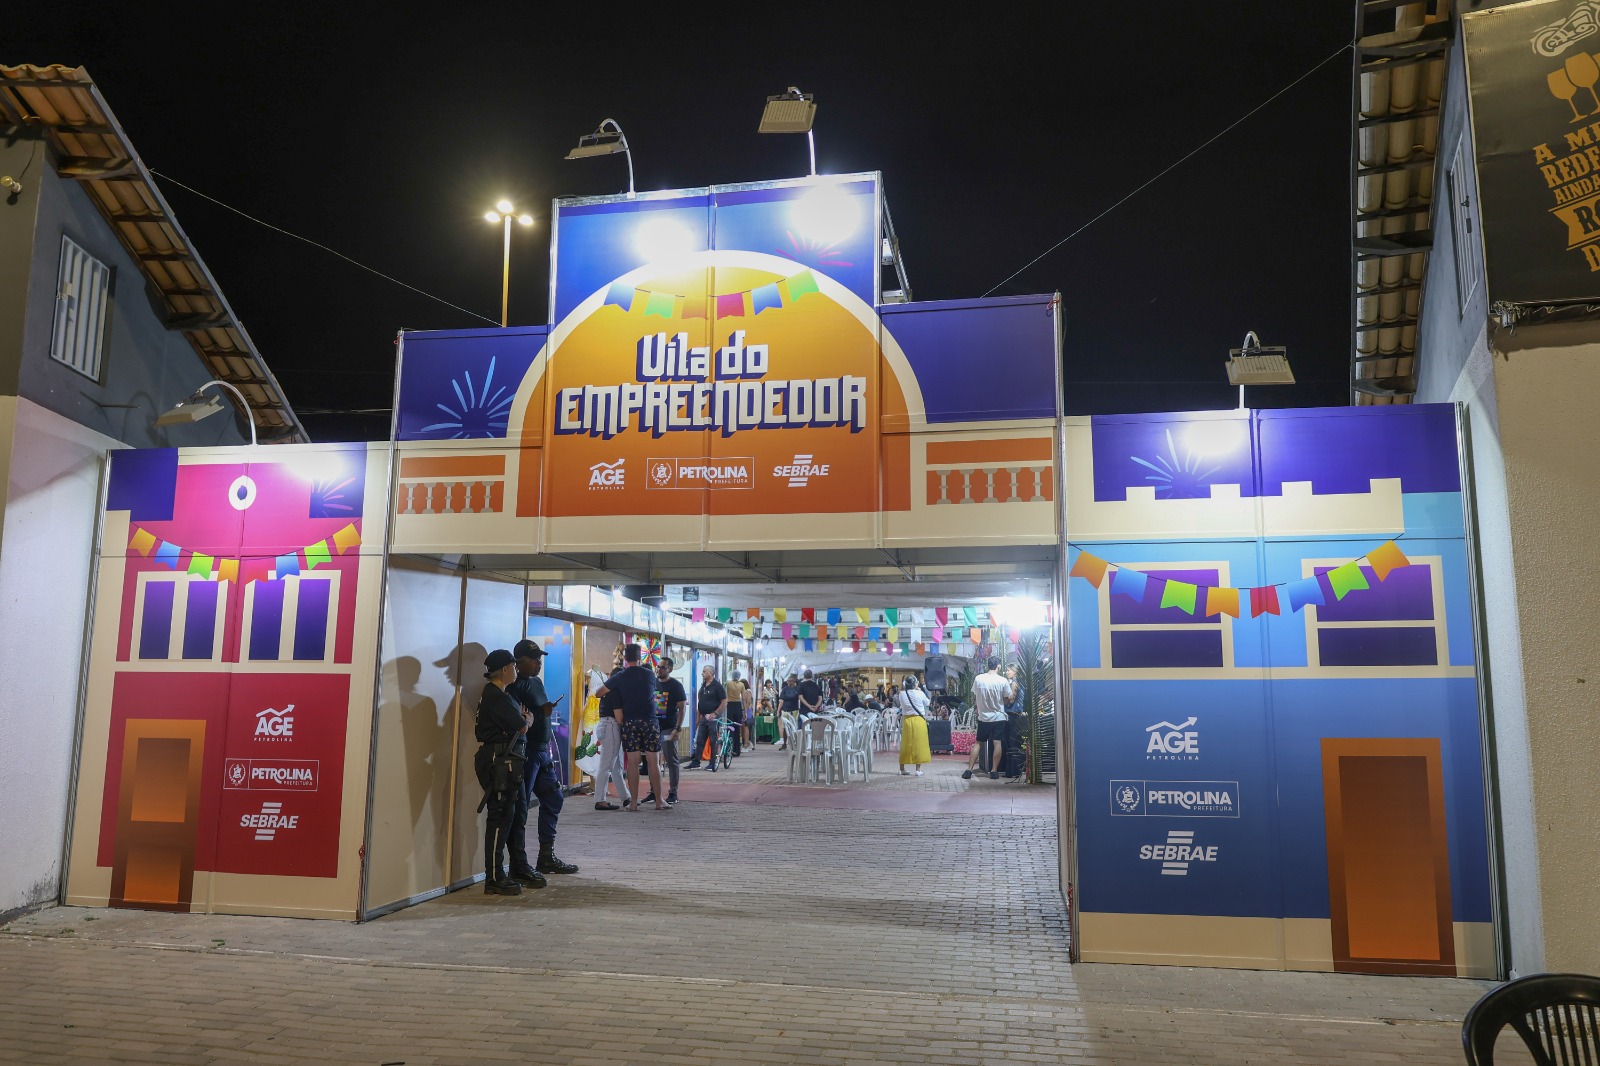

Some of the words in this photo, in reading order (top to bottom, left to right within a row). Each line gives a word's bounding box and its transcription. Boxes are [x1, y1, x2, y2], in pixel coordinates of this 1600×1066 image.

[1533, 143, 1556, 165] A
[715, 330, 768, 379] do
[554, 375, 866, 440] EMPREENDEDOR
[589, 470, 624, 485] AGE
[679, 466, 748, 480] PETROLINA
[772, 464, 830, 477] SEBRAE
[254, 717, 294, 736] AGE
[1146, 731, 1199, 753] AGE
[251, 768, 313, 782] PETROLINA
[1148, 790, 1232, 806] PETROLINA
[240, 814, 299, 829] SEBRAE
[1139, 844, 1219, 861] SEBRAE
